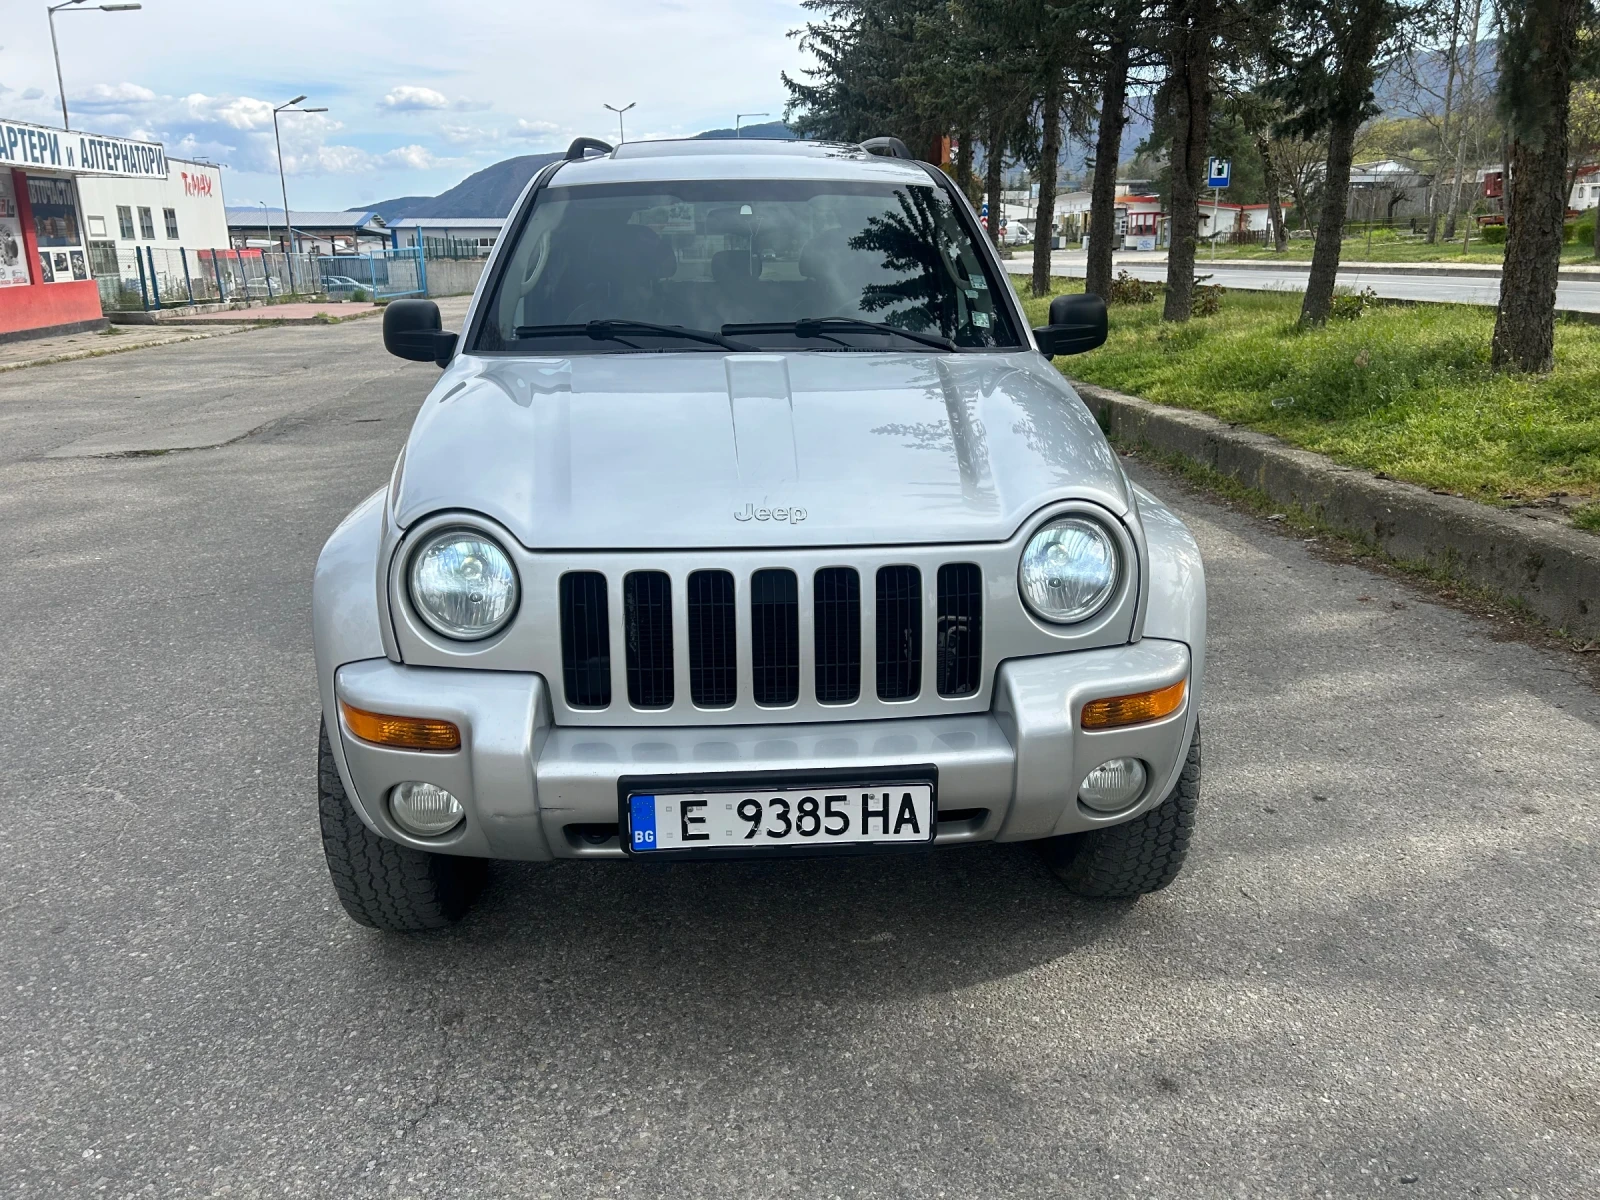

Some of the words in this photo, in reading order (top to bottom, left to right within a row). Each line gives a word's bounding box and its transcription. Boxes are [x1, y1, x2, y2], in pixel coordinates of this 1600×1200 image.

[0, 125, 61, 166] АРТЕРИ
[80, 138, 164, 175] АЛТЕРНАТОРИ
[734, 503, 807, 524] Jeep
[680, 799, 710, 841] E
[635, 830, 654, 843] BG
